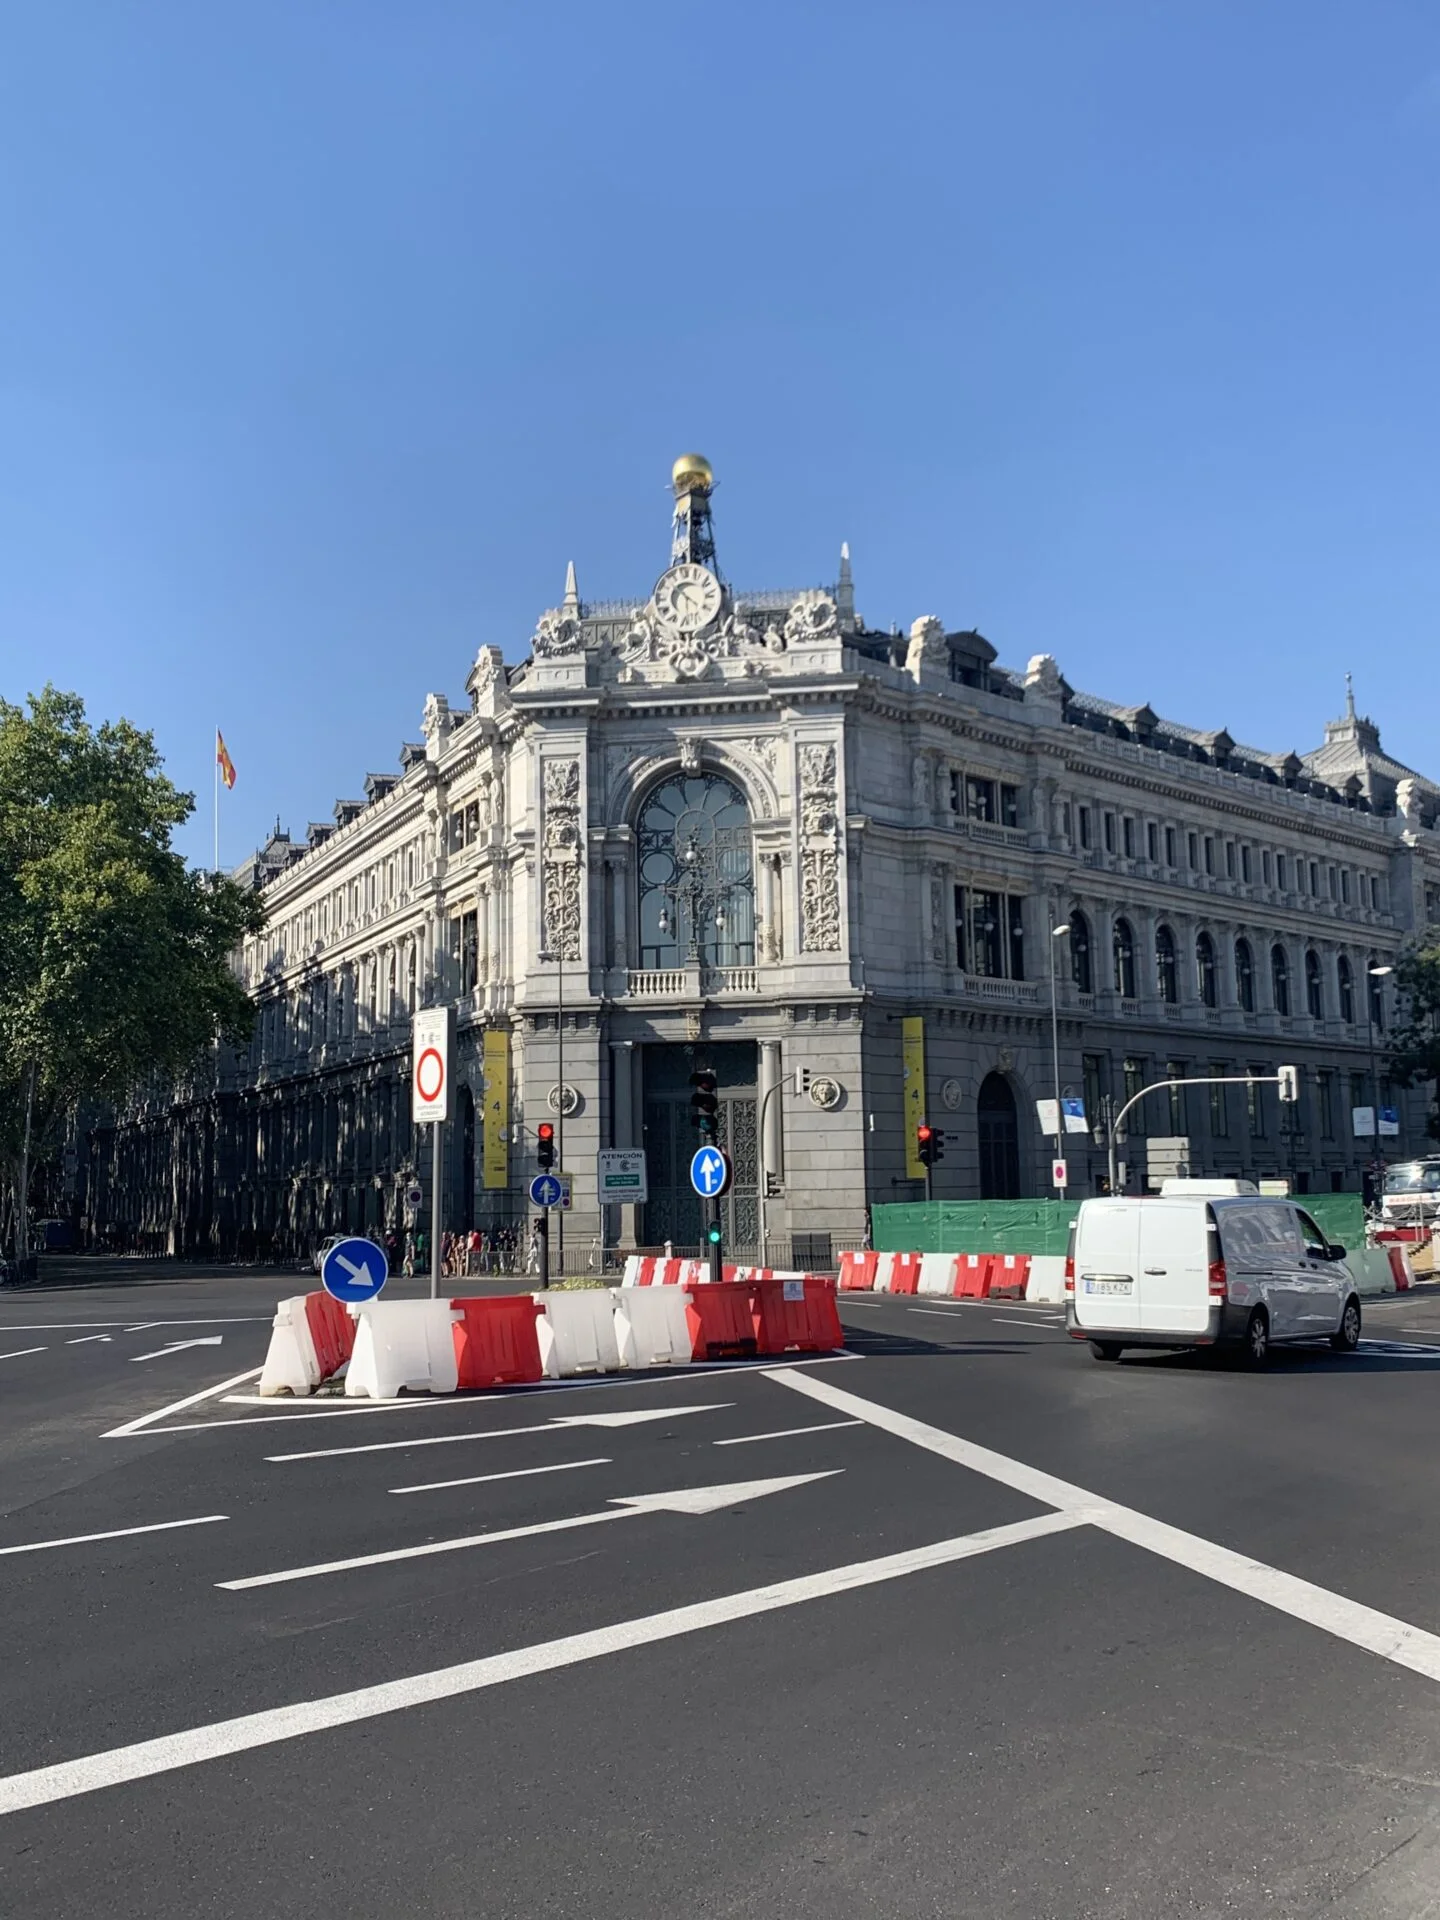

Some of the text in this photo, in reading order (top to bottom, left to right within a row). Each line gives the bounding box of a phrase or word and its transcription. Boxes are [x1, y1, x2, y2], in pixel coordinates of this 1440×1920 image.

[912, 1089, 919, 1099] 4
[492, 1101, 500, 1111] 4
[601, 1152, 642, 1160] ATENCIÓN
